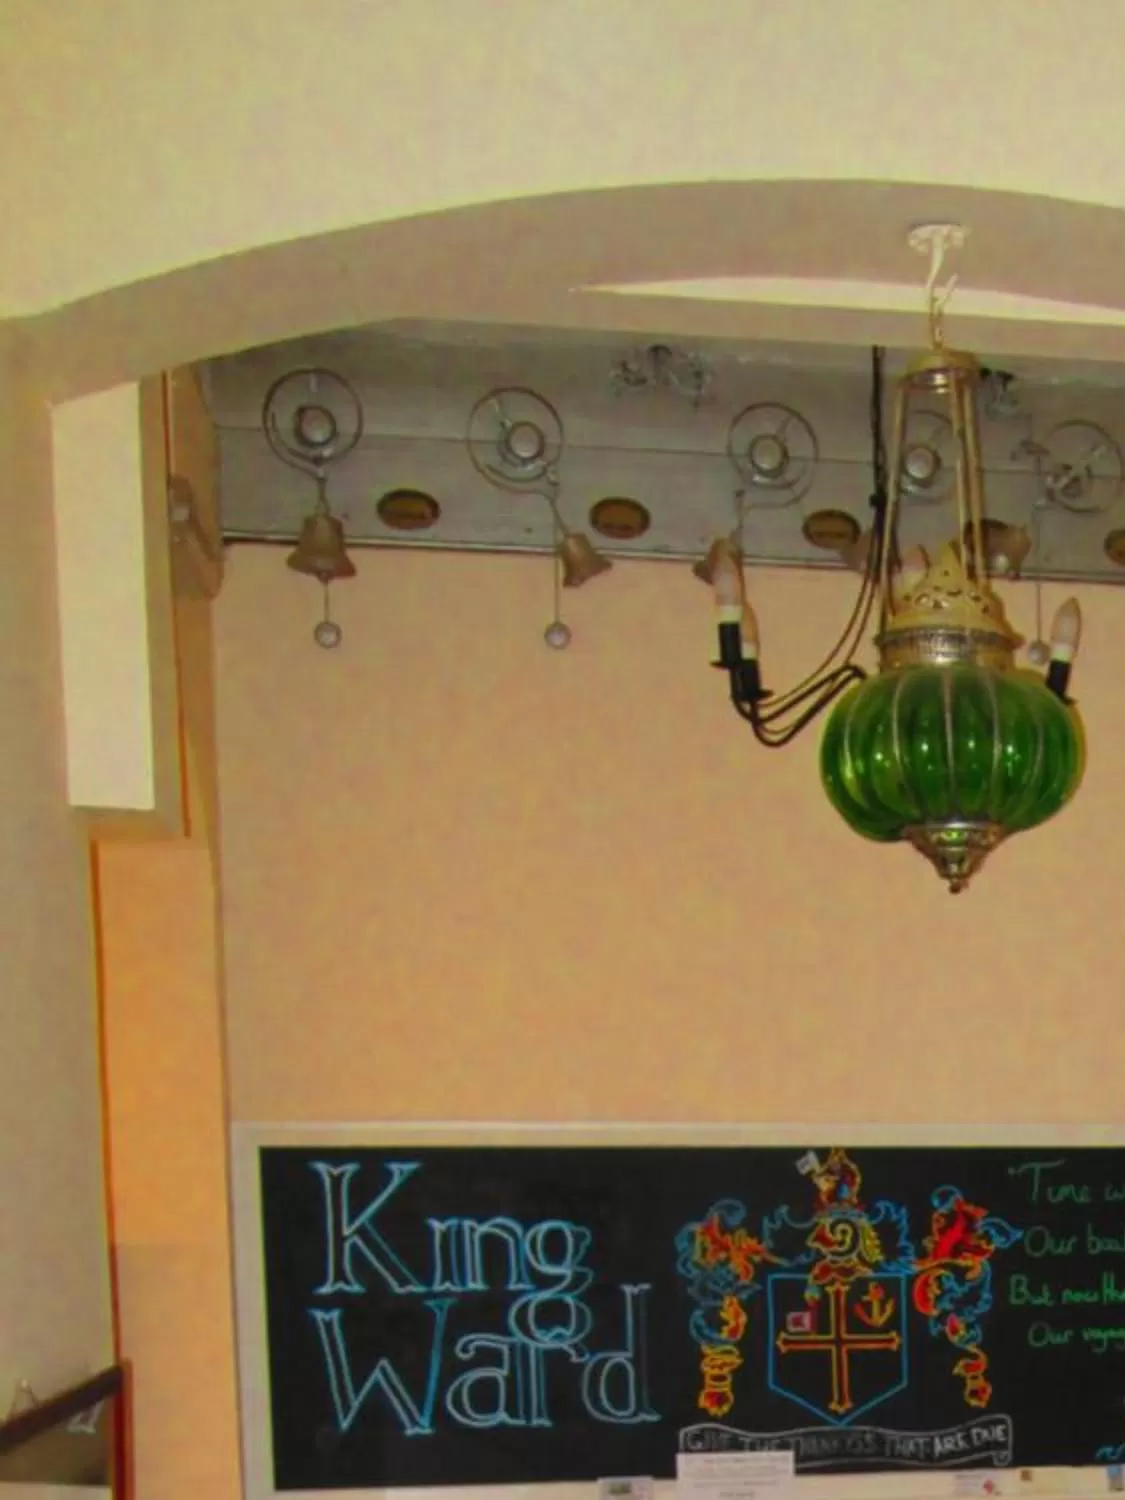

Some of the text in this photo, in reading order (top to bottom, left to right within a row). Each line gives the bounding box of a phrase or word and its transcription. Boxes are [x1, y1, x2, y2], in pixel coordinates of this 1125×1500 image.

[308, 1161, 593, 1348] King
[1024, 1225, 1078, 1258] Our
[1009, 1274, 1055, 1306] But
[1060, 1287, 1099, 1305] now
[1028, 1321, 1075, 1348] Our
[307, 1284, 662, 1435] Ward
[933, 1432, 970, 1457] ARE
[969, 1423, 1008, 1447] DUE
